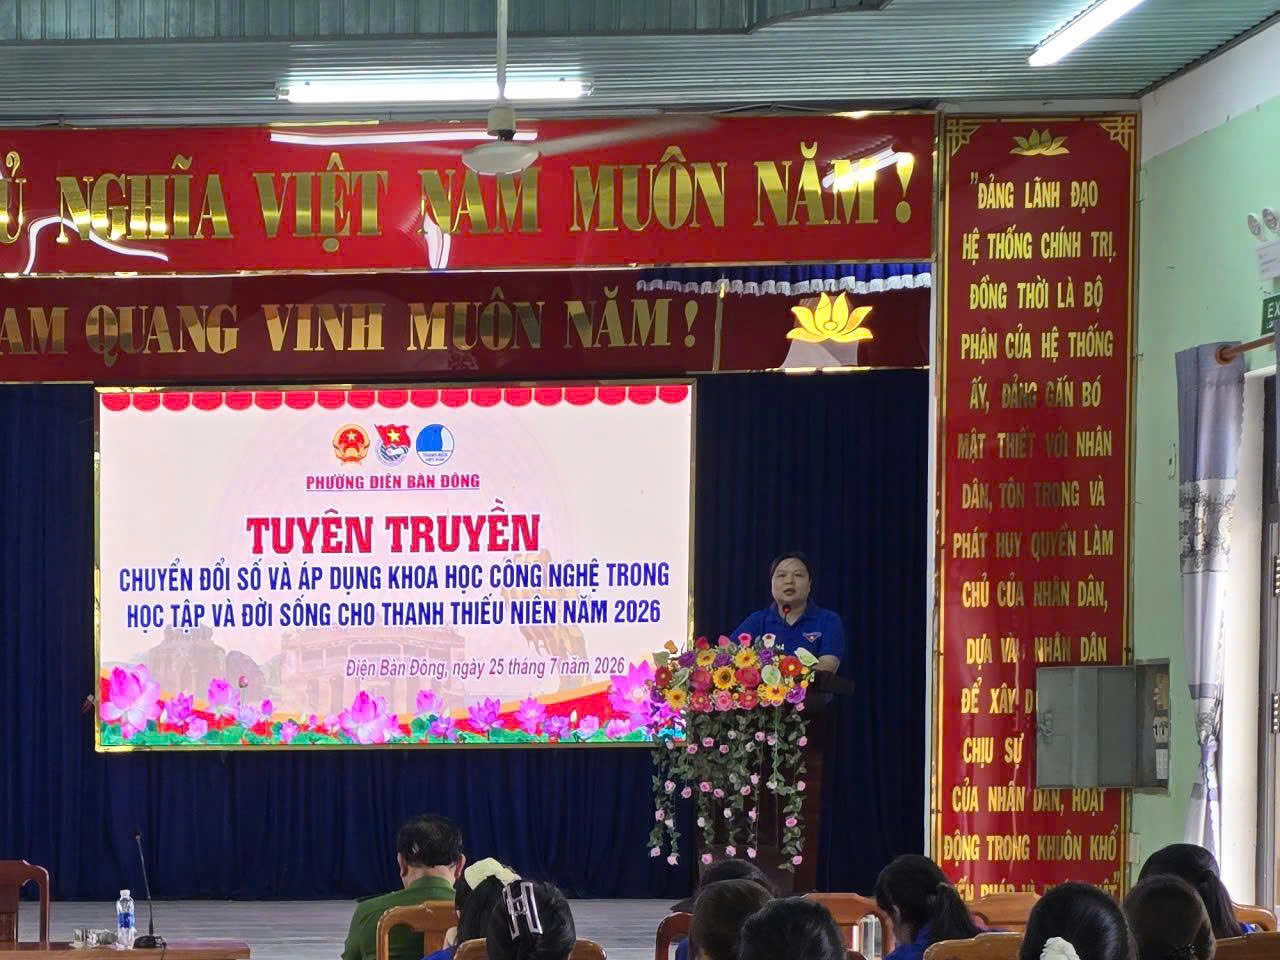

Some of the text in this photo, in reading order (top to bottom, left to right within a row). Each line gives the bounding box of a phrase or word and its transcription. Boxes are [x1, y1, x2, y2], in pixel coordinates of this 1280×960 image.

[56, 154, 233, 244] NGHĨA
[253, 152, 388, 253] VIỆT
[417, 167, 541, 234] NAM
[570, 145, 727, 232] MUÔN
[1025, 176, 1060, 208] LÃNH
[1070, 180, 1098, 213] ĐẠO
[962, 227, 980, 265] HỆ
[987, 224, 1032, 259] THỐNG
[1041, 226, 1081, 258] CHÍNH
[970, 274, 1104, 312] ĐỒNG THỜI LÀ BỘ
[85, 303, 239, 368] QUANG
[261, 303, 386, 352] VINH
[407, 287, 545, 351] MUÔN
[961, 323, 1113, 364] PHẬN CỦA HỆ THỐNG
[1082, 375, 1102, 407] BÓ
[1076, 425, 1112, 457] NHÂN
[1090, 475, 1105, 507] VÀ
[246, 498, 541, 554] TUYÊN TRUYỀN
[953, 524, 1114, 558] PHÁT LÀM
[119, 557, 669, 595] CHUYỂN ĐỔI SỐ VÀ ÁP DỤNG KHOA HỌC CÔNG NGHỆ TRONG
[962, 572, 990, 607] CHỦ
[1078, 574, 1108, 612] DÂN,
[127, 593, 660, 634] HỌC TẬP VÀ ĐỜI SỐNG CHO THANH THIẾU NIÊN NĂM 2026
[346, 657, 625, 680] Điện Bàn Đông, ngày 25 tháng 7 năm 2026
[966, 634, 992, 670] DỰA
[1080, 632, 1107, 662] DÂN
[961, 677, 982, 714] ĐỂ
[990, 683, 1016, 714] XÂY
[963, 733, 1024, 768] CHỊU SỰ
[952, 777, 979, 812] CỦA
[988, 780, 1025, 811] NHÂN
[944, 824, 1119, 866] ĐỘNG TRONG KHUÔN KHỔ
